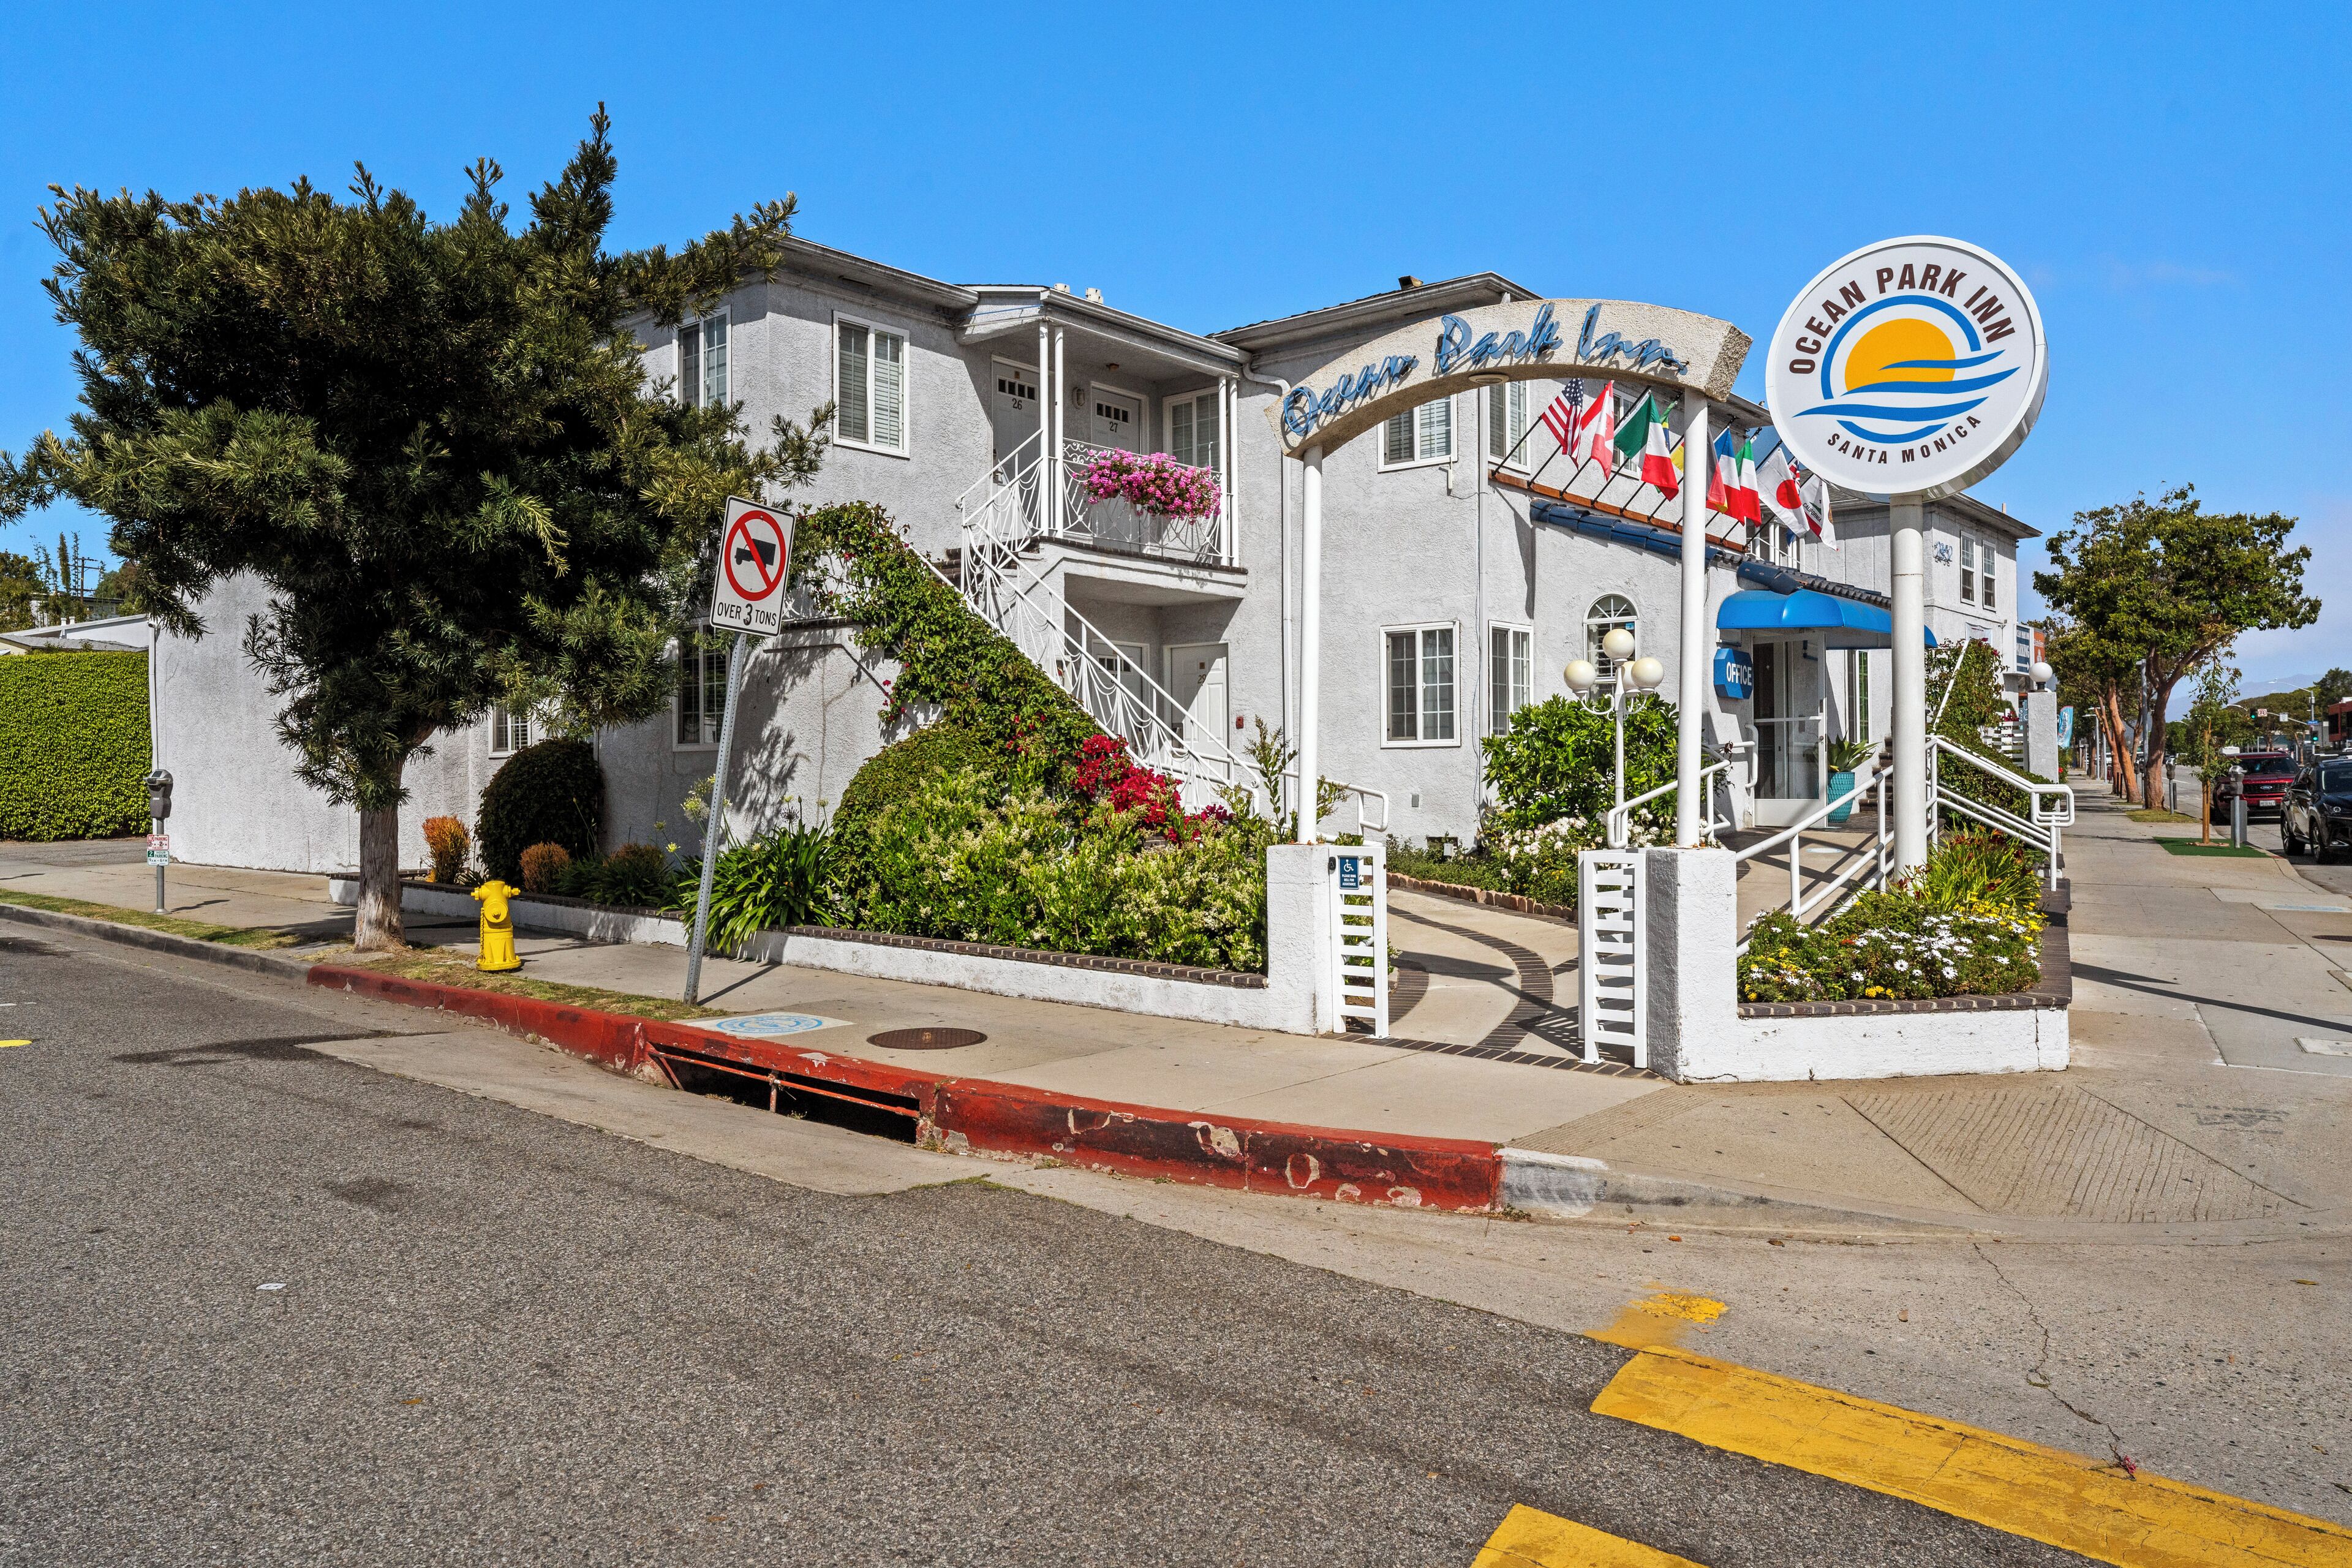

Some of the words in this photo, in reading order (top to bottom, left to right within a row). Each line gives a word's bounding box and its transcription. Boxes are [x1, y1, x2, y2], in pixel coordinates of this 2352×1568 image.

[1789, 280, 1866, 374] OCEAN
[1876, 263, 1967, 298] PARK
[1963, 285, 2015, 344] INN
[1436, 303, 1564, 374] Park
[1579, 303, 1689, 375] Inn
[1012, 398, 1022, 410] 26
[1109, 421, 1118, 433] 27
[1828, 433, 1887, 464] SANTA
[1901, 415, 1981, 463] MONICA
[1803, 502, 1822, 522] CALIFORNIA
[717, 602, 741, 619] OVER
[743, 603, 753, 626] 3
[755, 609, 777, 627] TONS
[1197, 674, 1207, 685] 29
[1726, 662, 1752, 686] OFFICE
